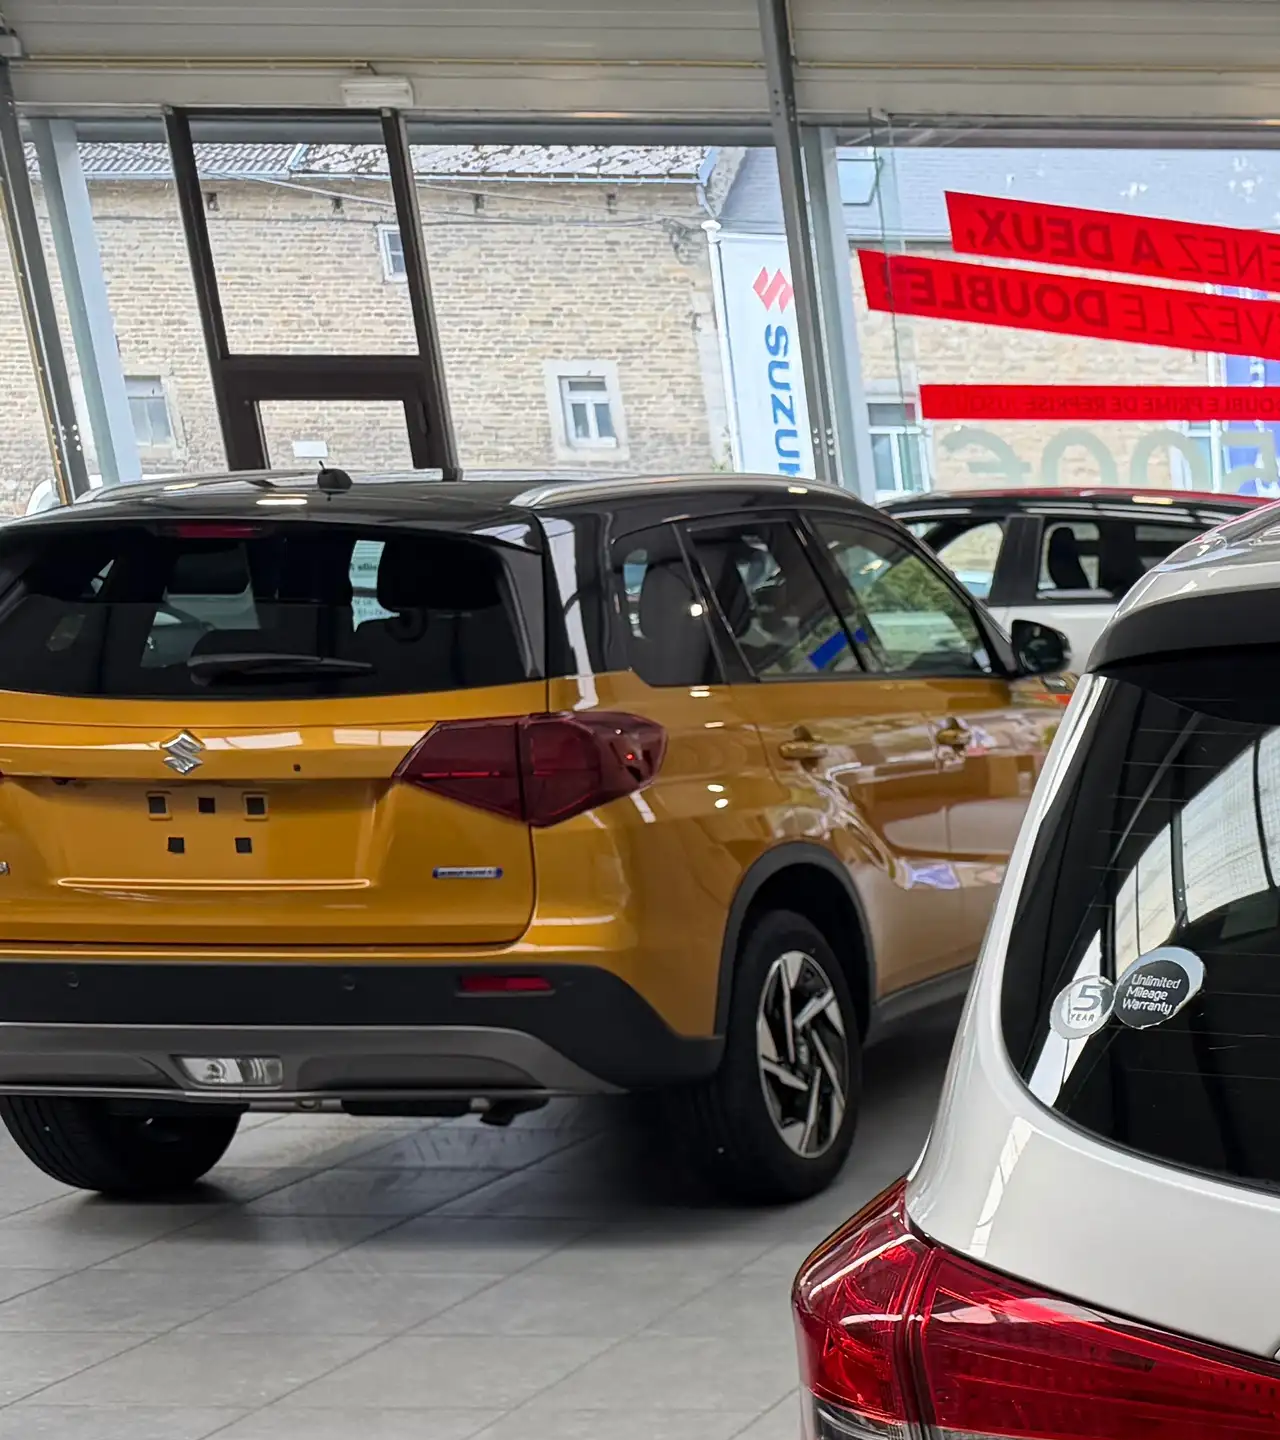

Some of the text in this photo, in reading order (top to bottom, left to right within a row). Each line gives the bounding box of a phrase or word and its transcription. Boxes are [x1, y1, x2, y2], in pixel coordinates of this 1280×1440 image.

[1131, 973, 1182, 990] Unlimited
[1072, 984, 1106, 1012] 5
[1126, 985, 1169, 1001] Mileage
[1122, 997, 1174, 1016] Warranty
[1069, 1012, 1096, 1023] YEAR
